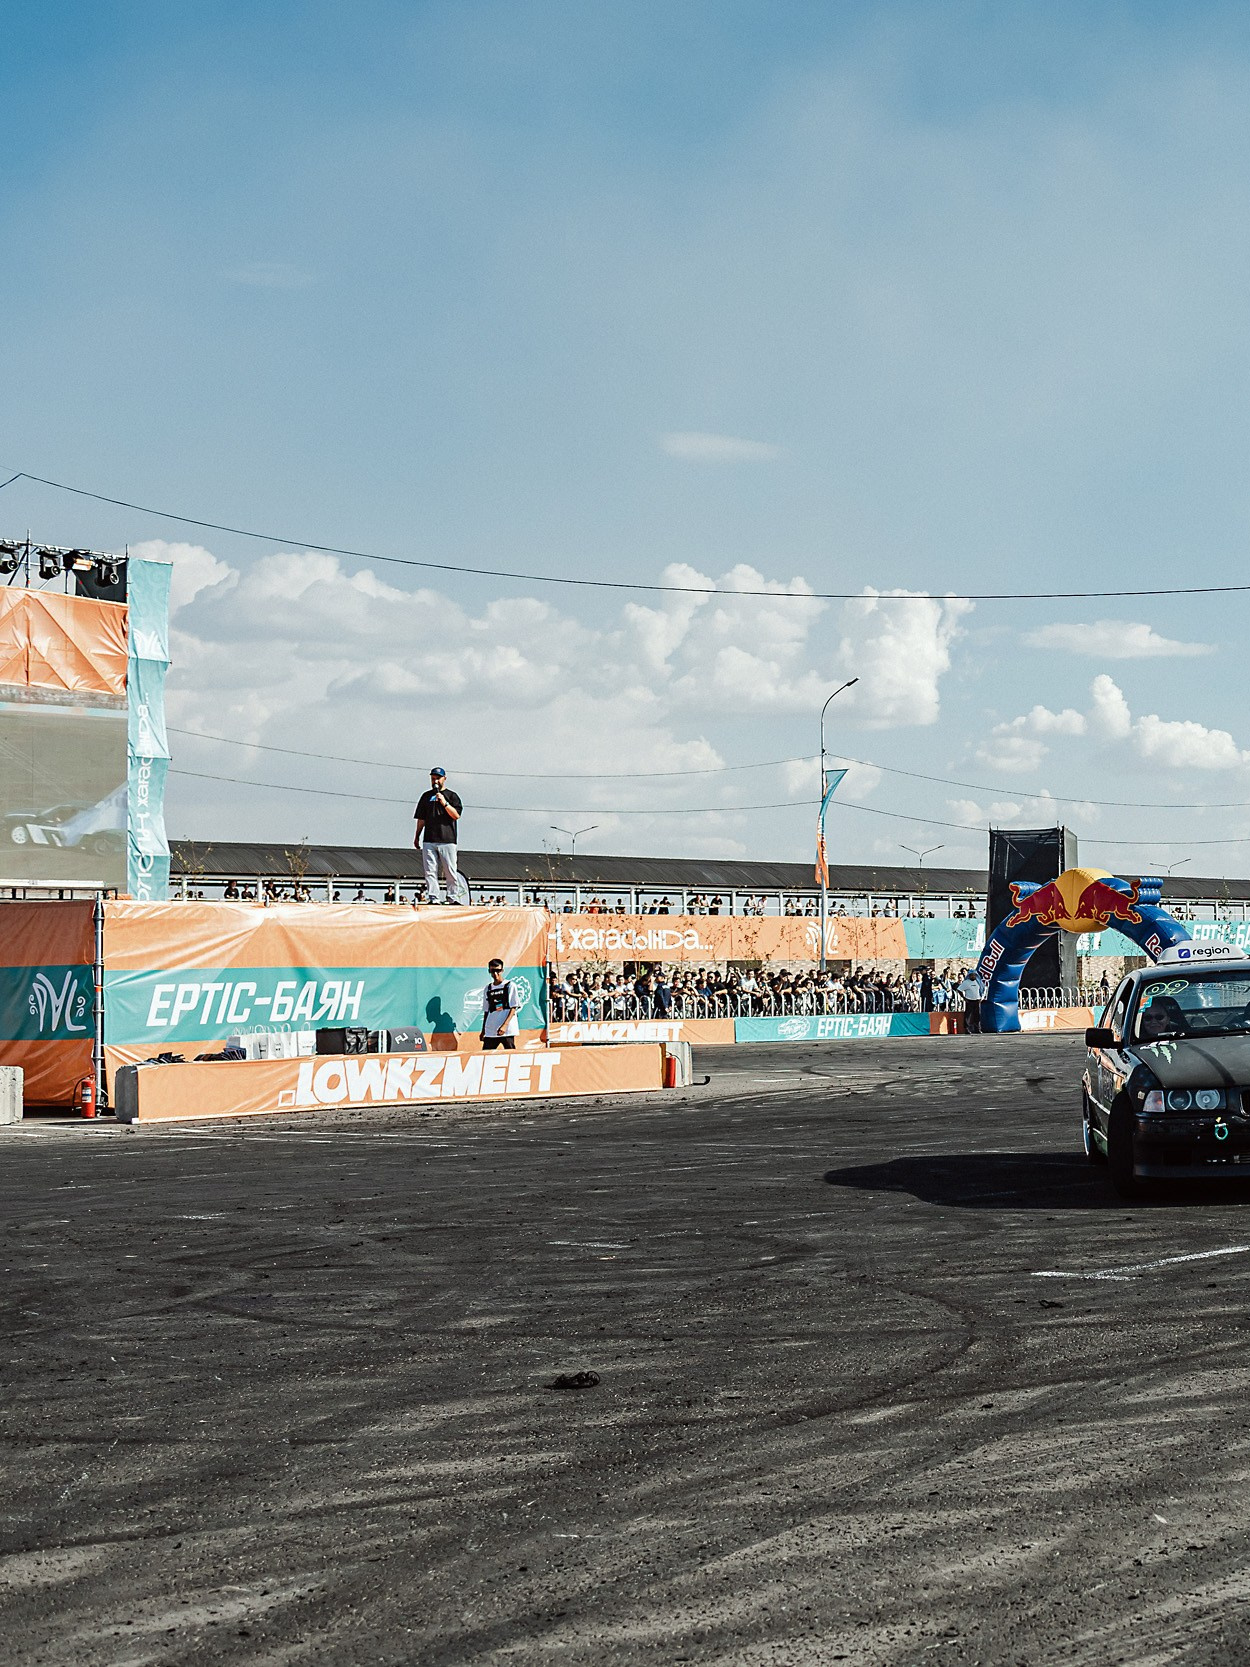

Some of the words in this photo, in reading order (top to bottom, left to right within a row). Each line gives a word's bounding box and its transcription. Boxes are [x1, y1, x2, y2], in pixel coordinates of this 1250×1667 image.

[981, 938, 1005, 971] Bull
[1145, 933, 1162, 957] Re
[1192, 946, 1230, 957] region
[295, 1052, 560, 1106] LOWKZMEET
